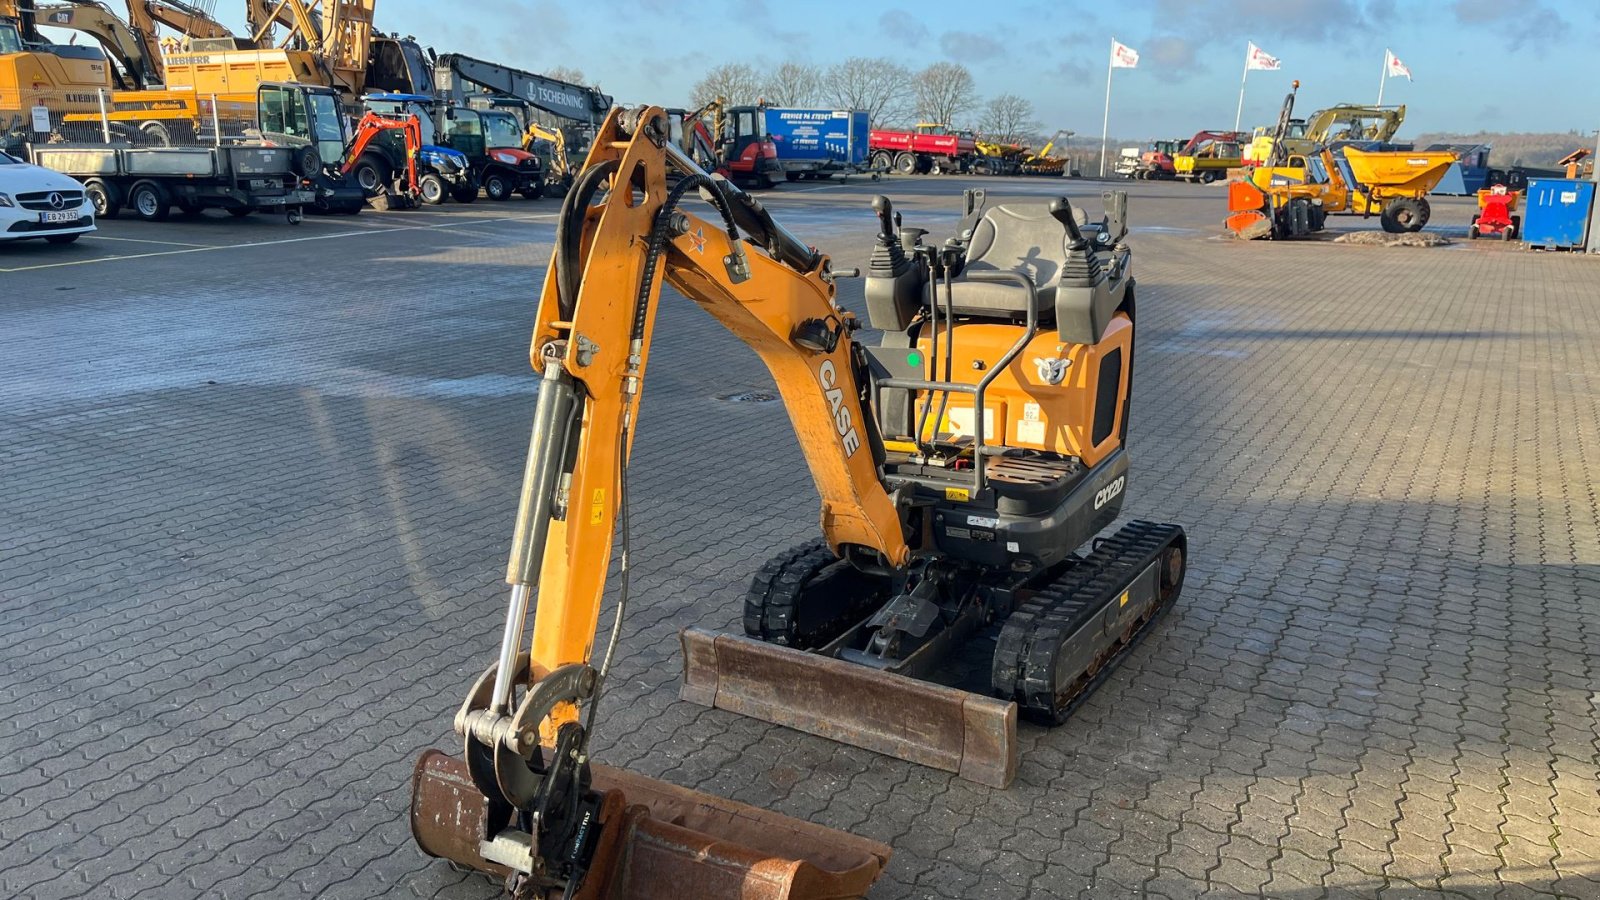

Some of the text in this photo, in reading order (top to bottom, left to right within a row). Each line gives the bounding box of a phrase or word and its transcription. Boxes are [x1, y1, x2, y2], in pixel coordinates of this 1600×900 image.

[57, 12, 69, 23] CAT
[166, 55, 210, 66] LIEBHERR
[538, 87, 584, 109] TSCHERNING
[780, 112, 802, 120] SERVICE
[47, 211, 77, 221] EB 29 352
[819, 359, 860, 459] CASE
